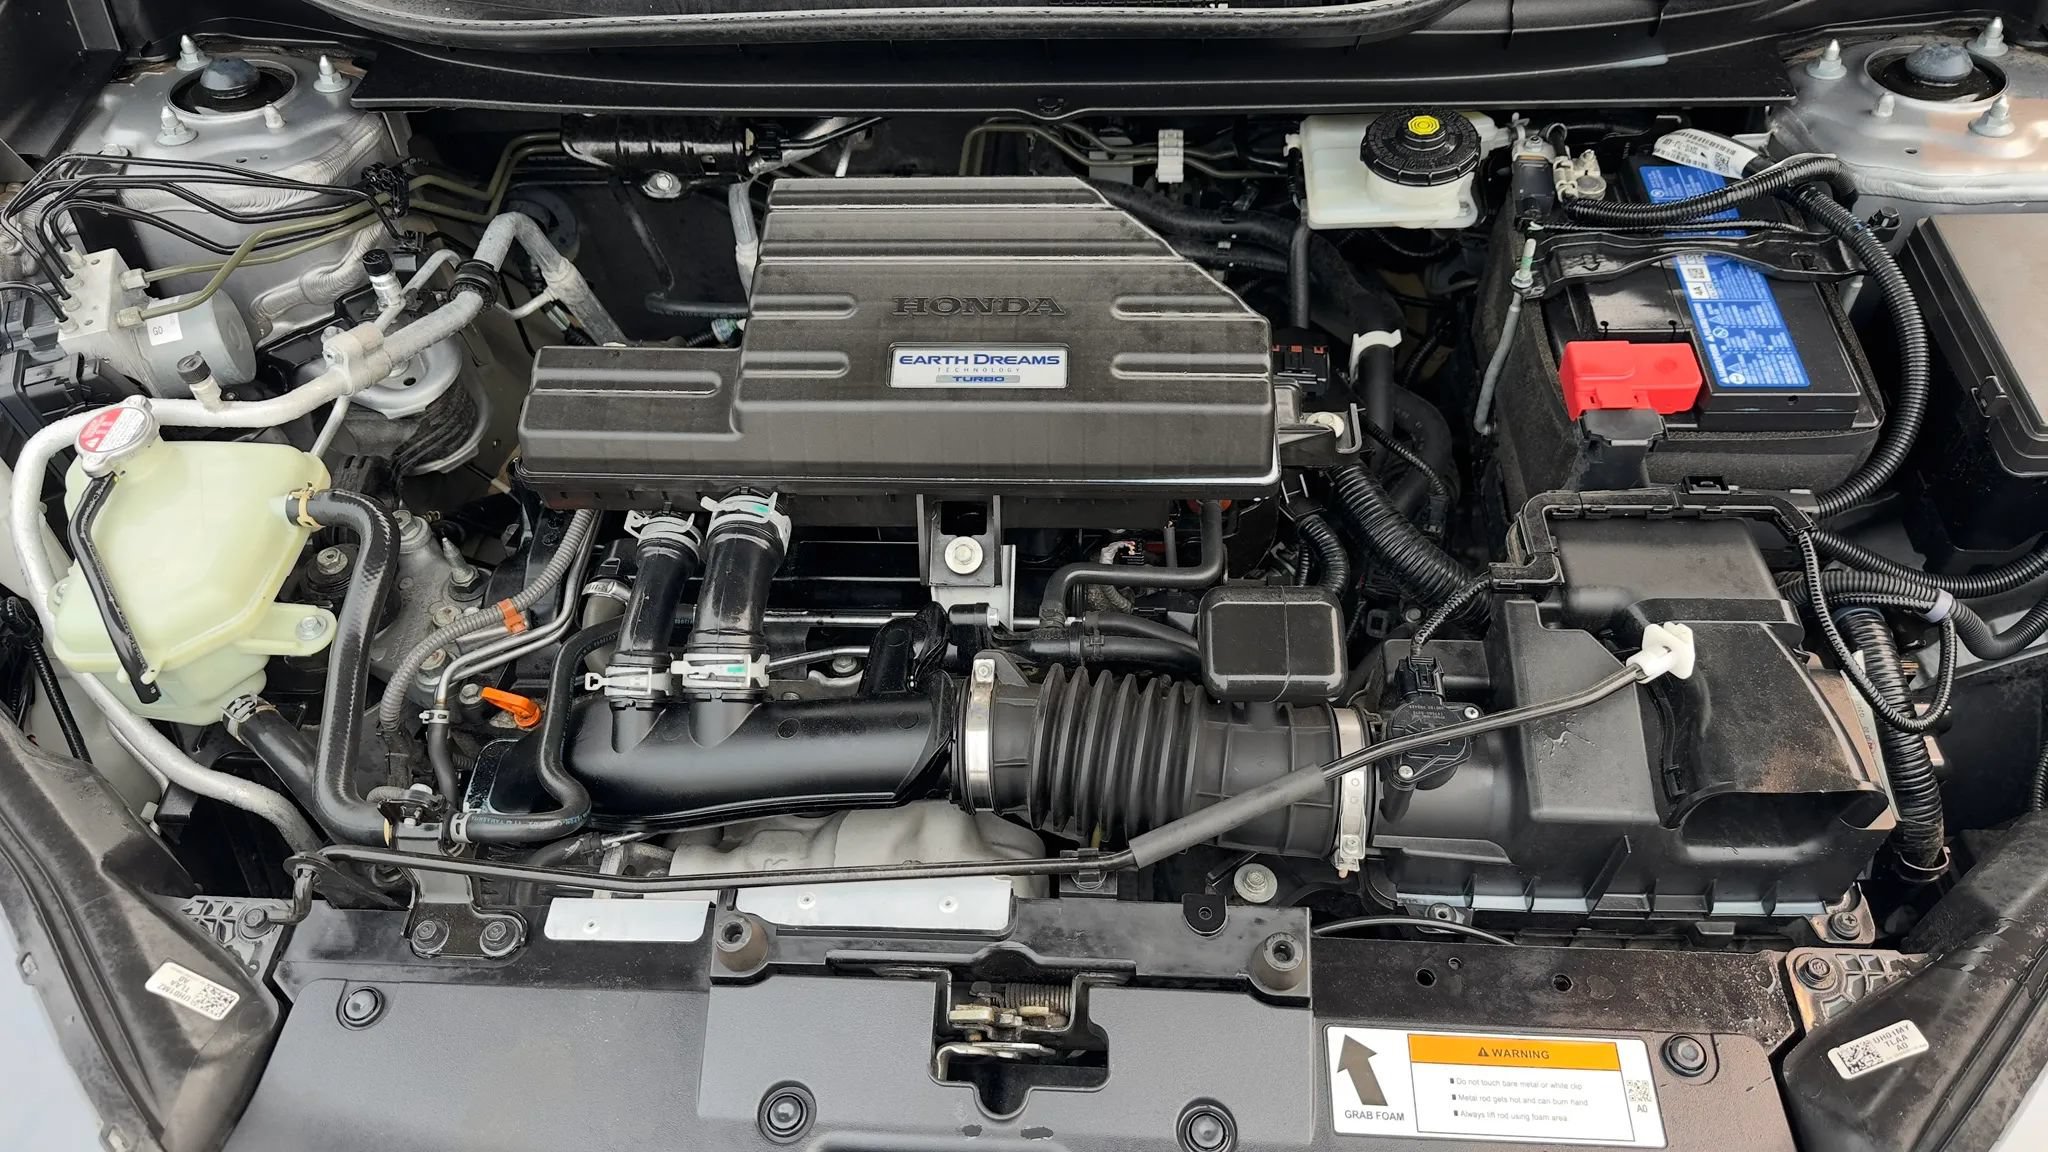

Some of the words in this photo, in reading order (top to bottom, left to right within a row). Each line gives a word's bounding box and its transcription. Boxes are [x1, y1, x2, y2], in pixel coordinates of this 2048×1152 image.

[892, 296, 1067, 316] HONDA
[899, 355, 969, 365] EARTH
[973, 353, 1060, 365] DREAMS
[952, 375, 1005, 383] TURBO
[1491, 1048, 1551, 1060] WARNING
[1456, 1077, 1467, 1085] Do
[1481, 1079, 1501, 1087] touch
[1502, 1080, 1518, 1088] bare
[1493, 1096, 1508, 1104] gets
[1570, 1098, 1589, 1106] hand
[1344, 1109, 1374, 1121] GRAB
[1376, 1110, 1405, 1122] FOAM
[1460, 1110, 1486, 1120] Always
[1486, 1111, 1496, 1119] lift
[1497, 1112, 1509, 1120] rod
[1511, 1113, 1531, 1122] using
[1531, 1112, 1550, 1121] foam
